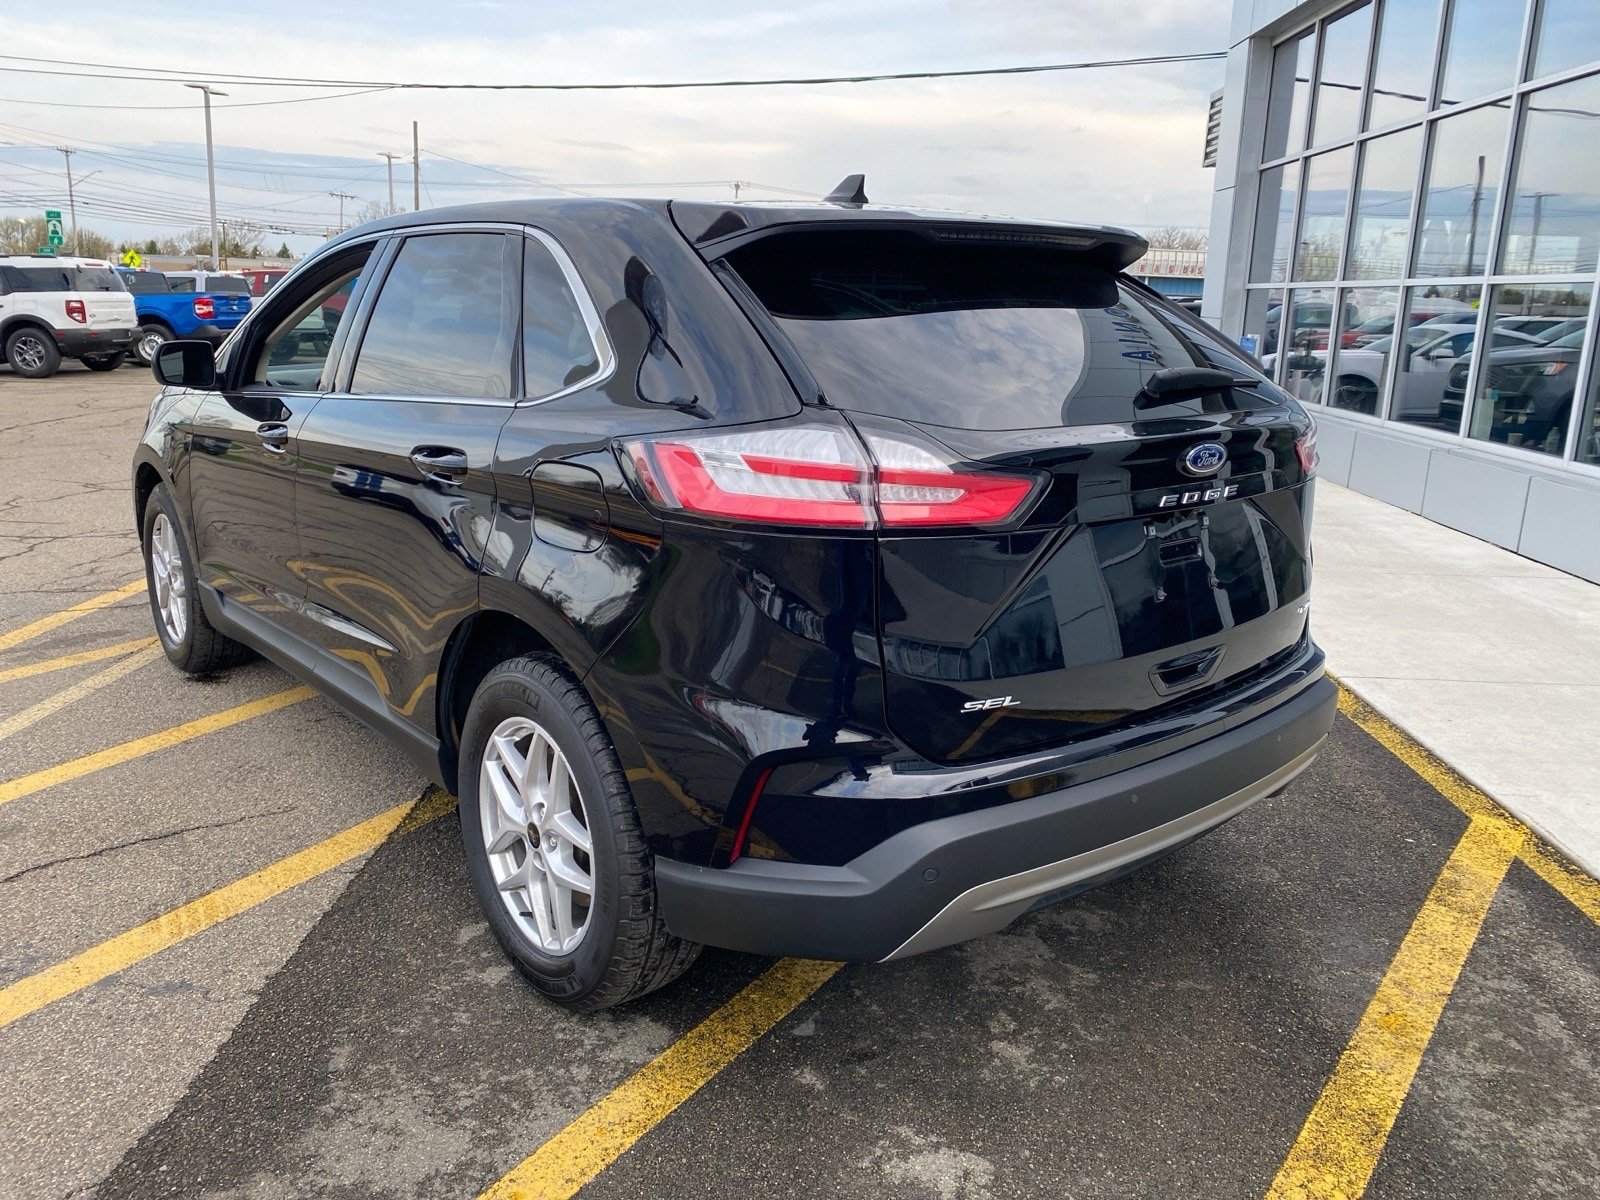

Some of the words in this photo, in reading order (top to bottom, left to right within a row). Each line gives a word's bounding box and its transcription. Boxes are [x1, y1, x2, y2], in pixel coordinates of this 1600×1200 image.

[1197, 449, 1220, 467] Ford
[1159, 484, 1240, 508] EDGE
[960, 695, 1022, 714] SEL
